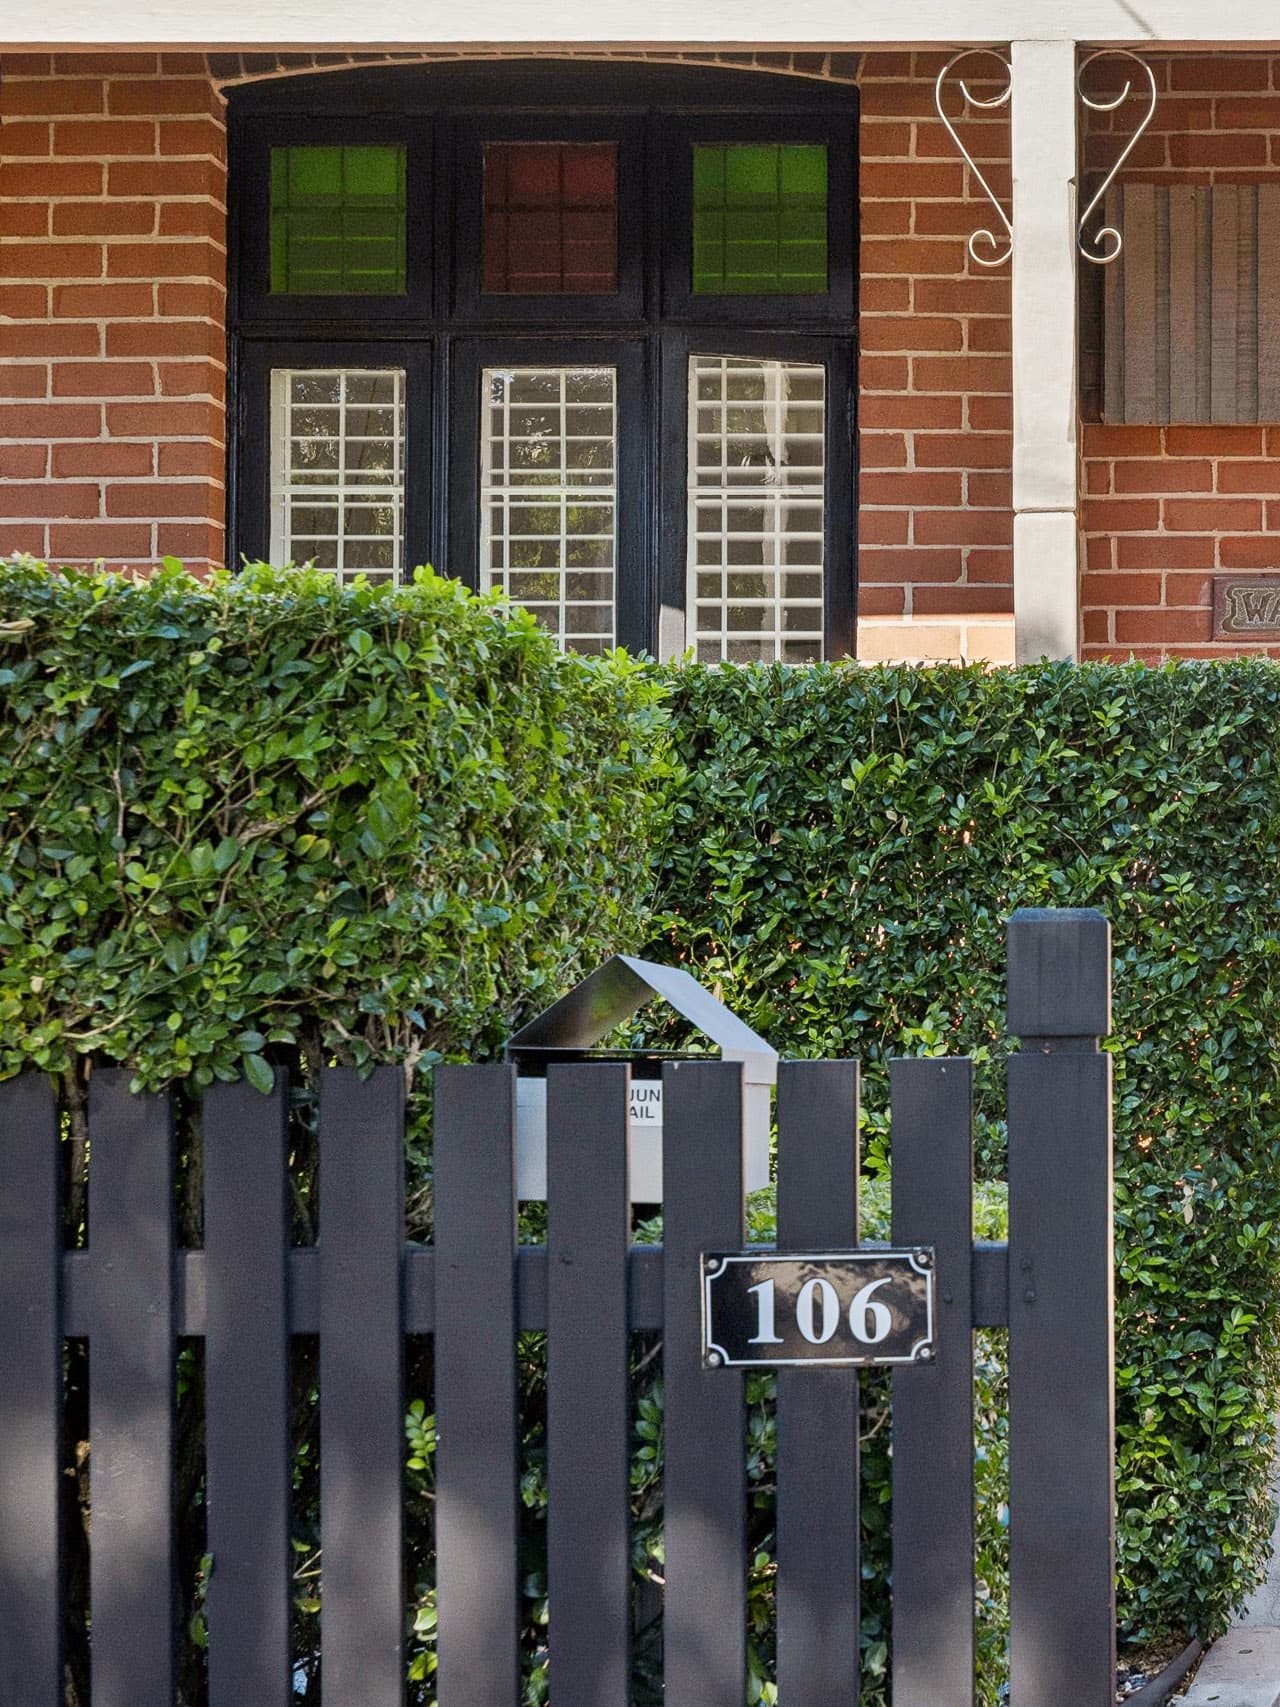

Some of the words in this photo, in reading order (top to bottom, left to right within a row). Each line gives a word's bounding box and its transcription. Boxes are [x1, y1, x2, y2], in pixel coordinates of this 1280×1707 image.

[630, 1089, 661, 1102] JUN
[630, 1106, 655, 1118] AIL
[747, 1277, 893, 1344] 106
